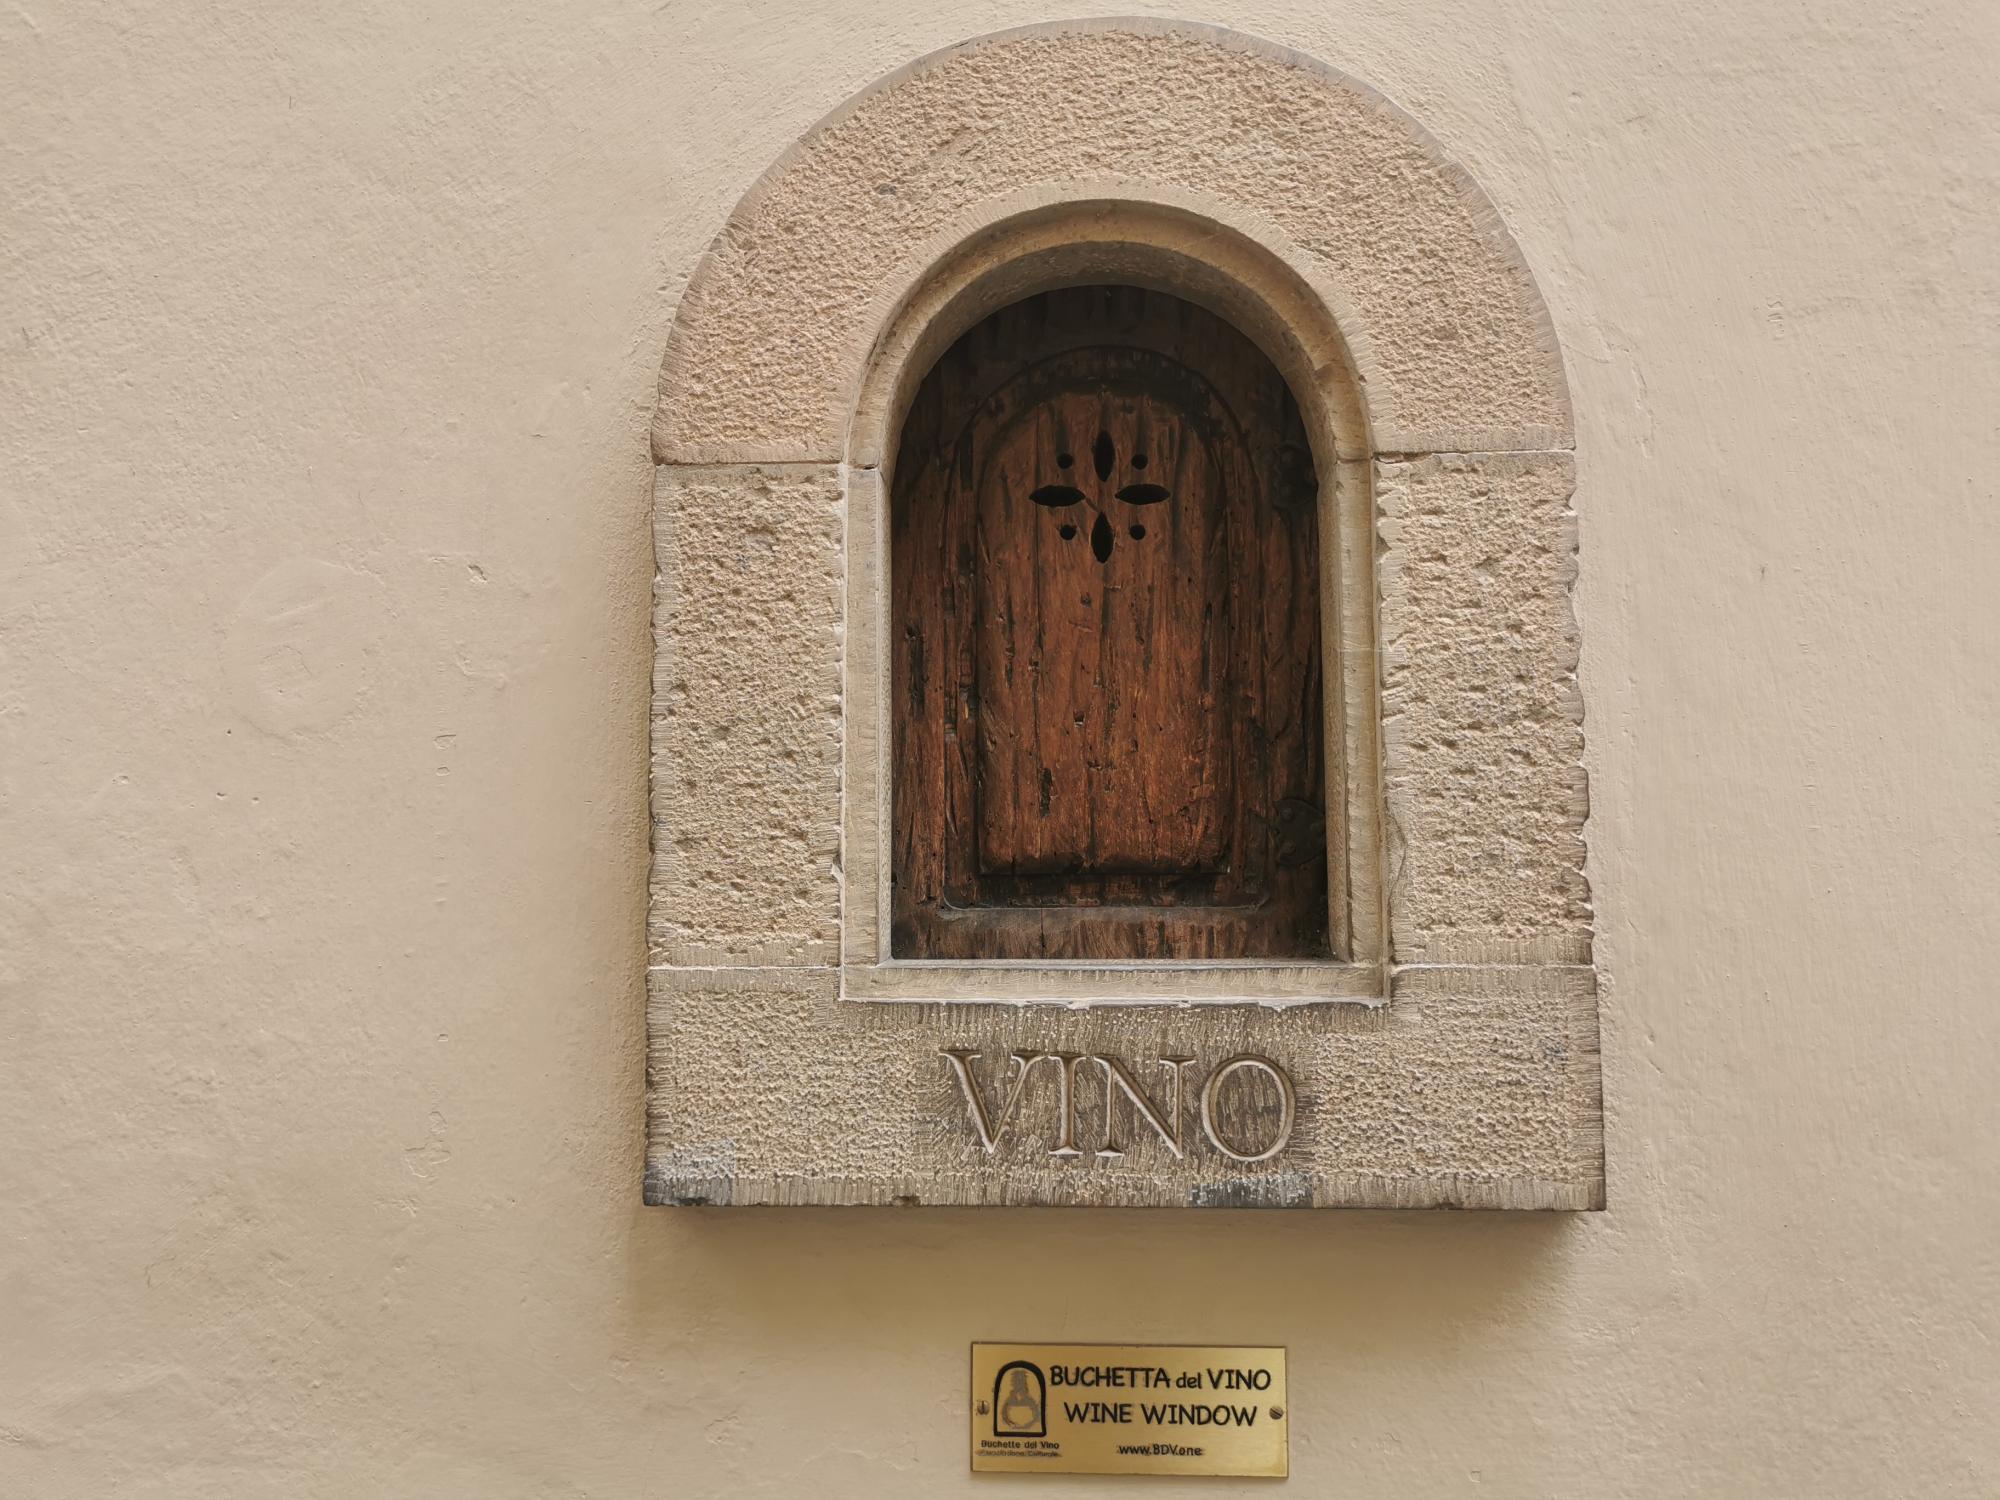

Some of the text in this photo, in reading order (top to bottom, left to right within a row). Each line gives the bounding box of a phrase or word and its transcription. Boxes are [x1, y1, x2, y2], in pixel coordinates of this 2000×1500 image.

[941, 1049, 1297, 1162] VINO
[1050, 1365, 1271, 1391] BUCHETTA del VINO
[1064, 1402, 1257, 1426] WINE WINDOW
[1040, 1441, 1060, 1449] Vino
[1119, 1443, 1202, 1456] www.BDV.one
